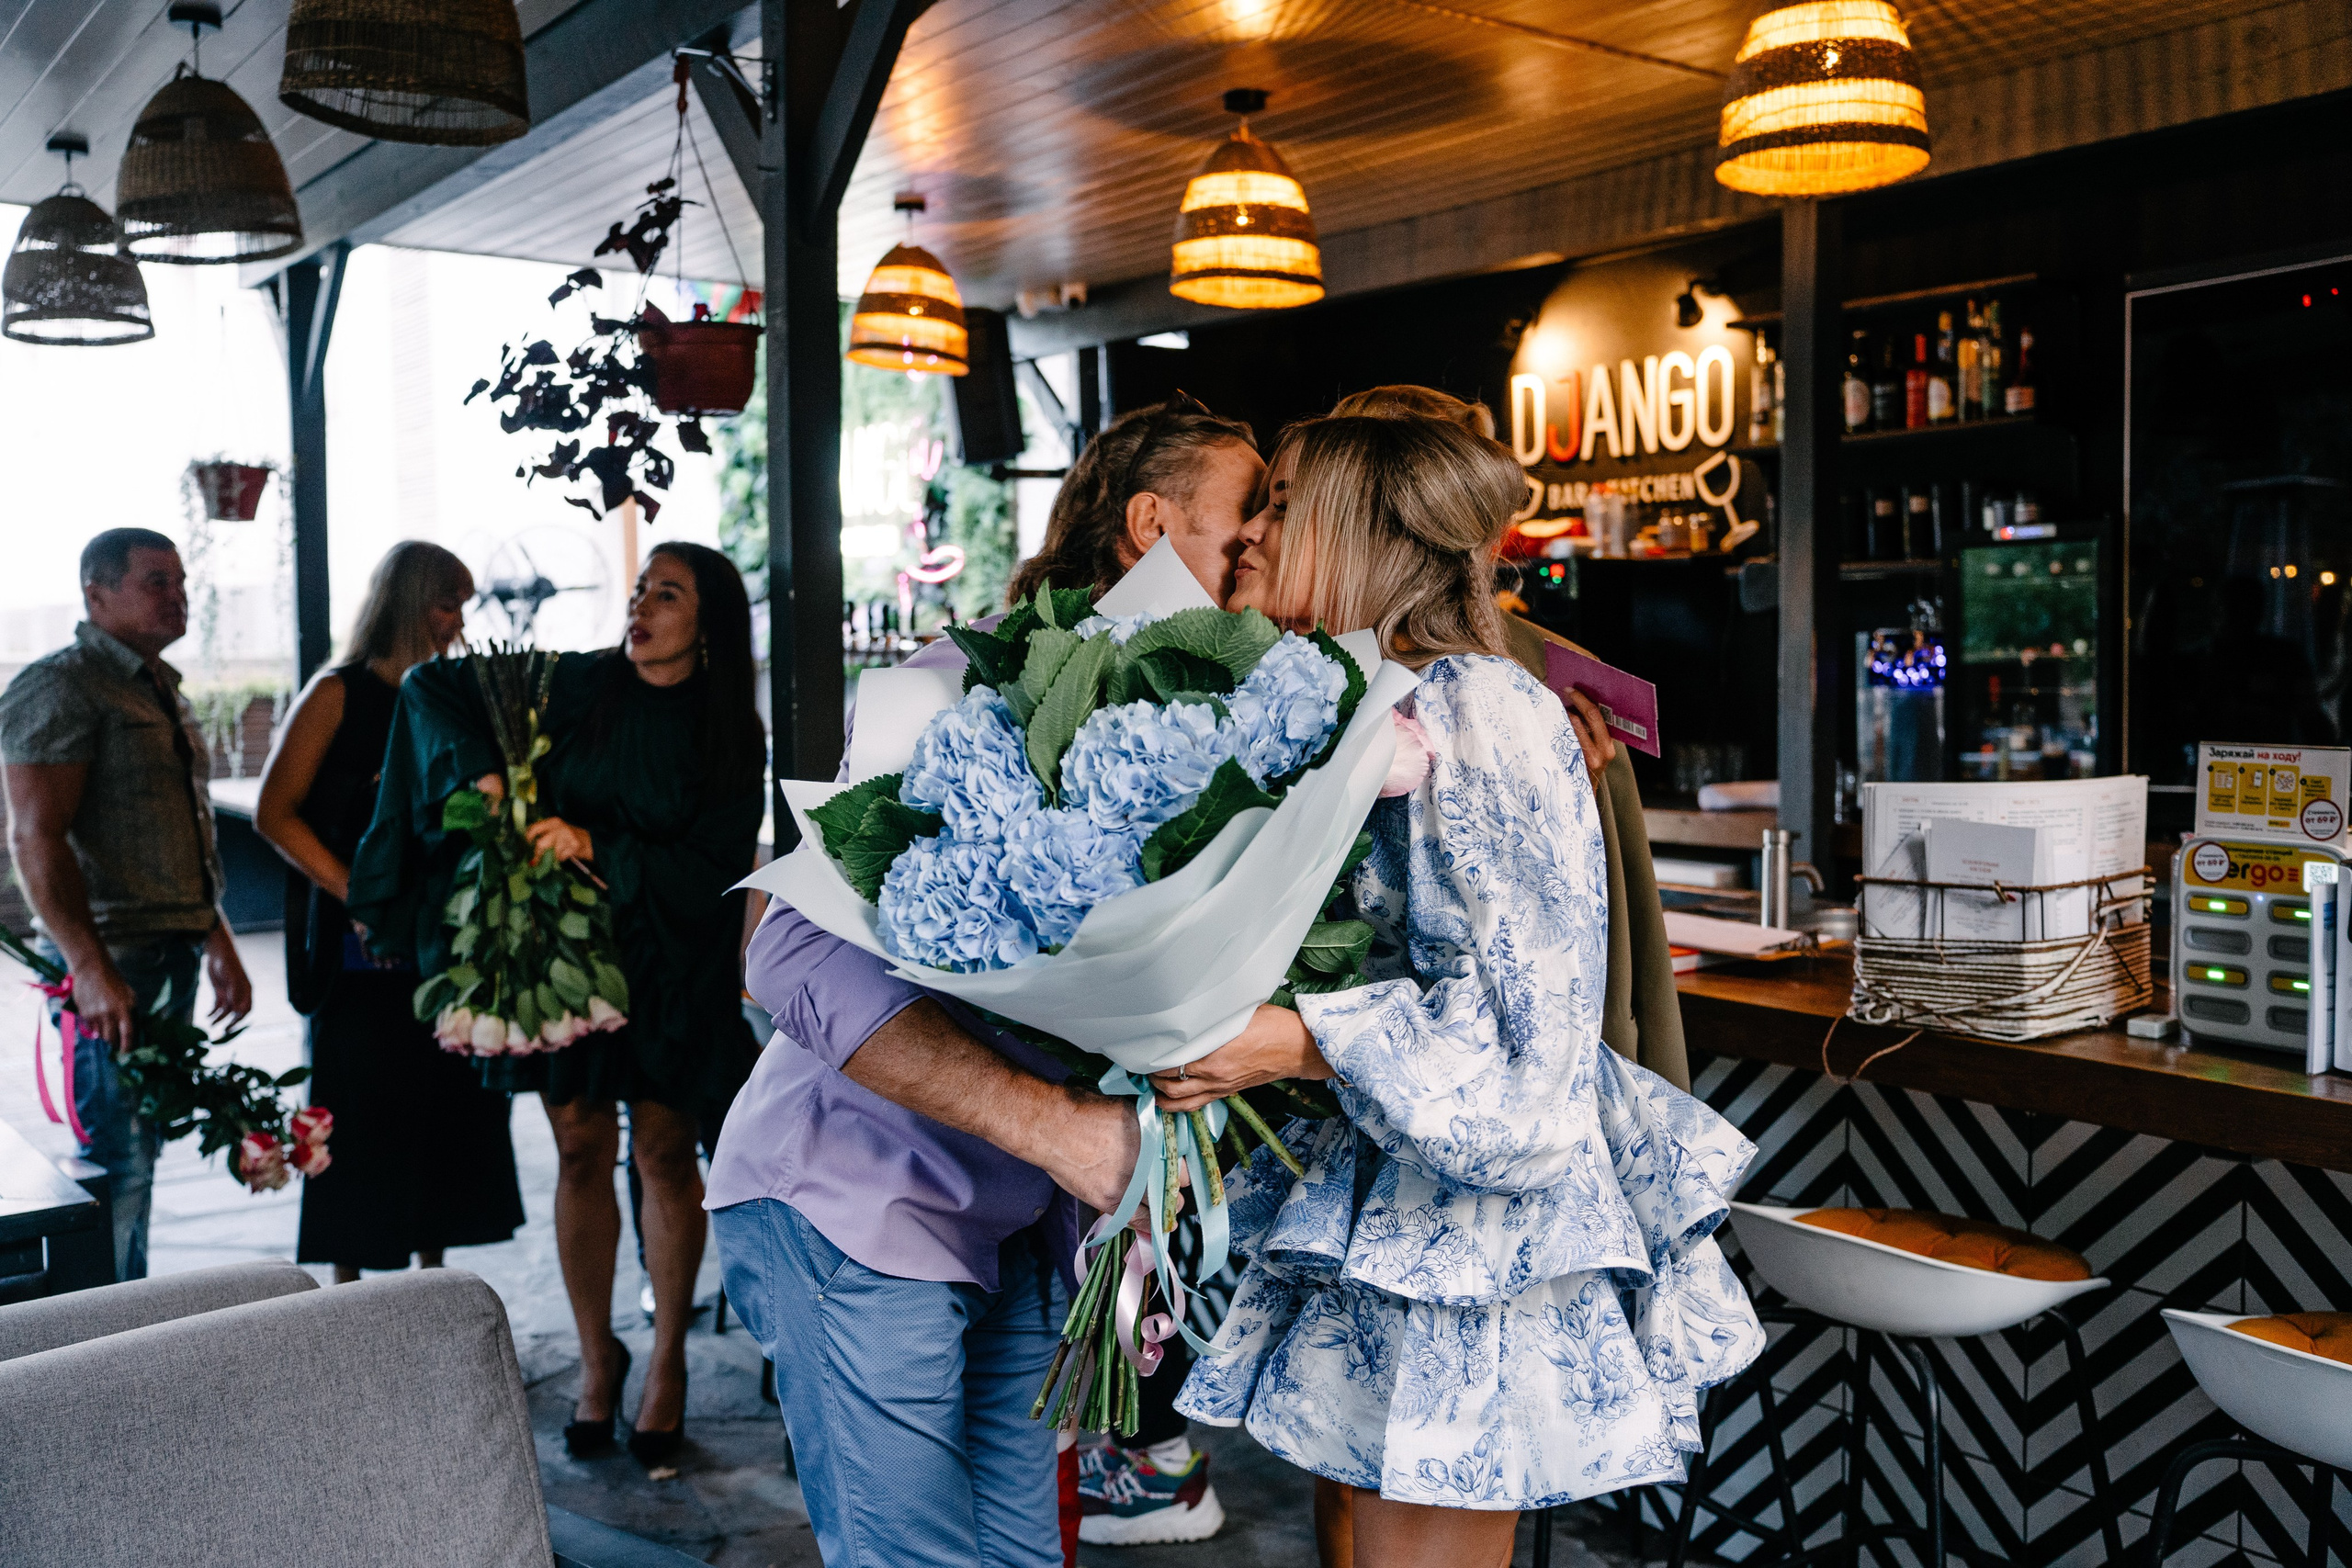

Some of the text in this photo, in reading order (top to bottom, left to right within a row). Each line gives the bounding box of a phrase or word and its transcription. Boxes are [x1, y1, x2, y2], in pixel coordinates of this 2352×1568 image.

[1510, 344, 1736, 467] DJANGO
[1547, 473, 1696, 511] BAR TCHEN
[2209, 747, 2301, 763] Заряжай на ходу!
[2317, 816, 2328, 824] 69
